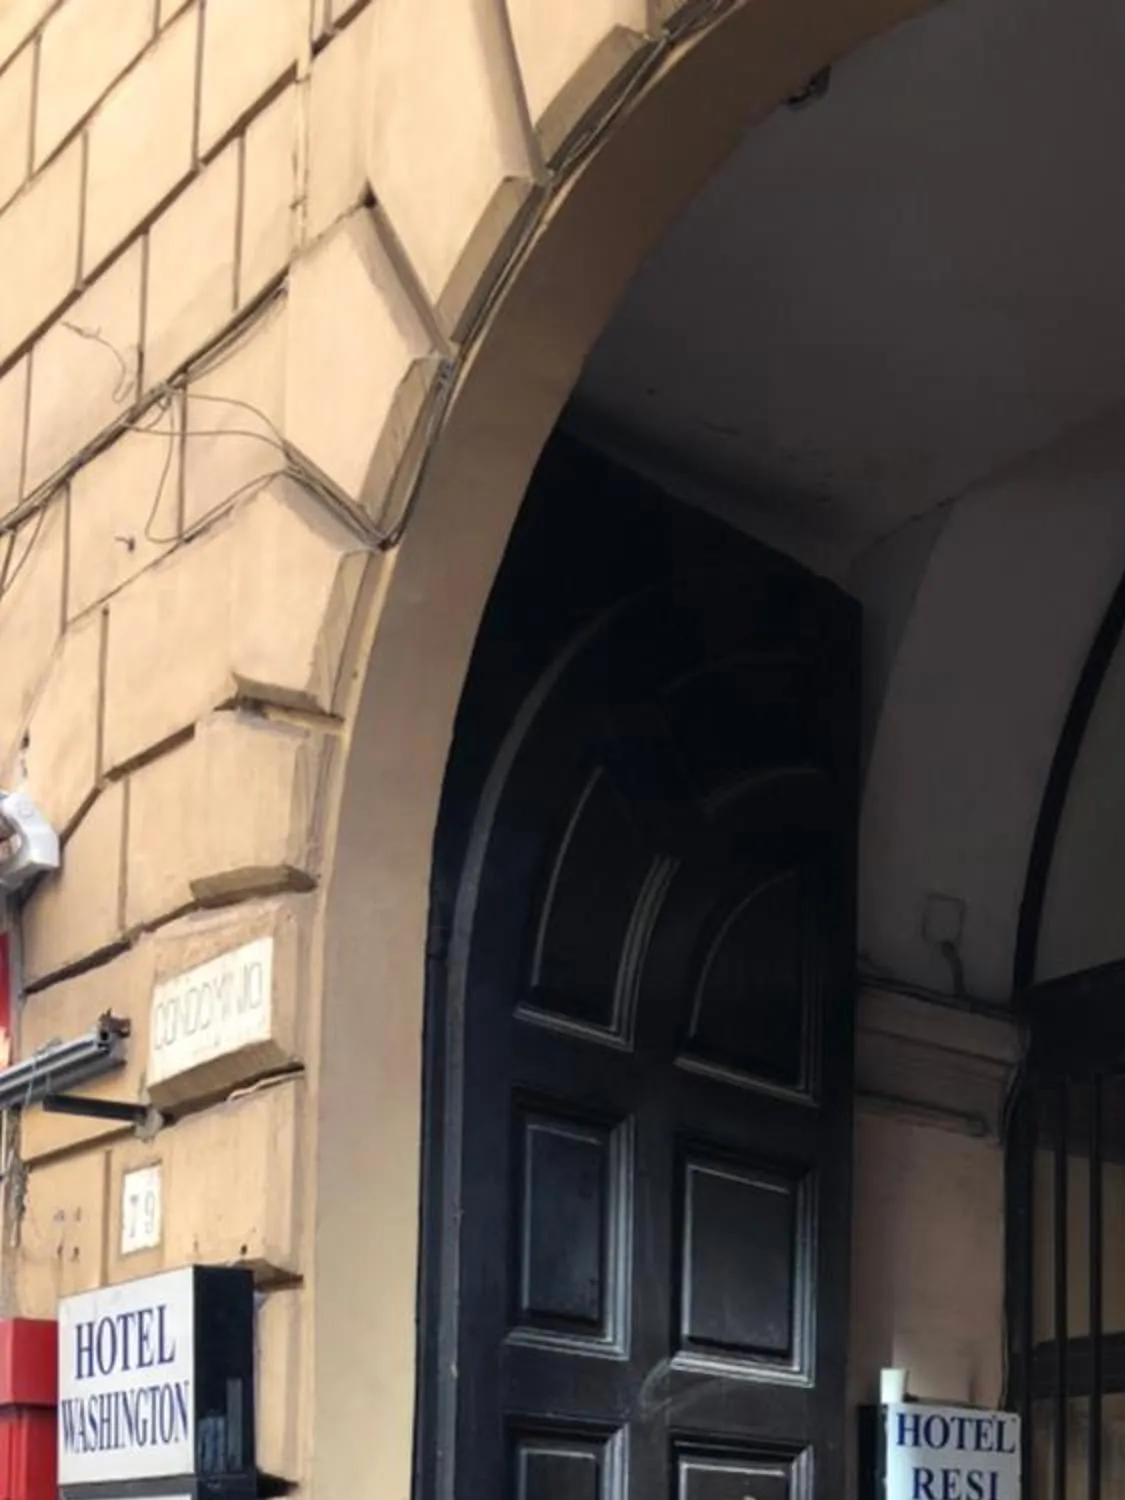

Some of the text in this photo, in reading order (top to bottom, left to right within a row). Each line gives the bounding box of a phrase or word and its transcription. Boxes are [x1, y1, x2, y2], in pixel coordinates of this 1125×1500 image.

[75, 1304, 177, 1381] HOTEL
[61, 1380, 191, 1455] WASHINGTON
[896, 1411, 1017, 1455] HOTEL
